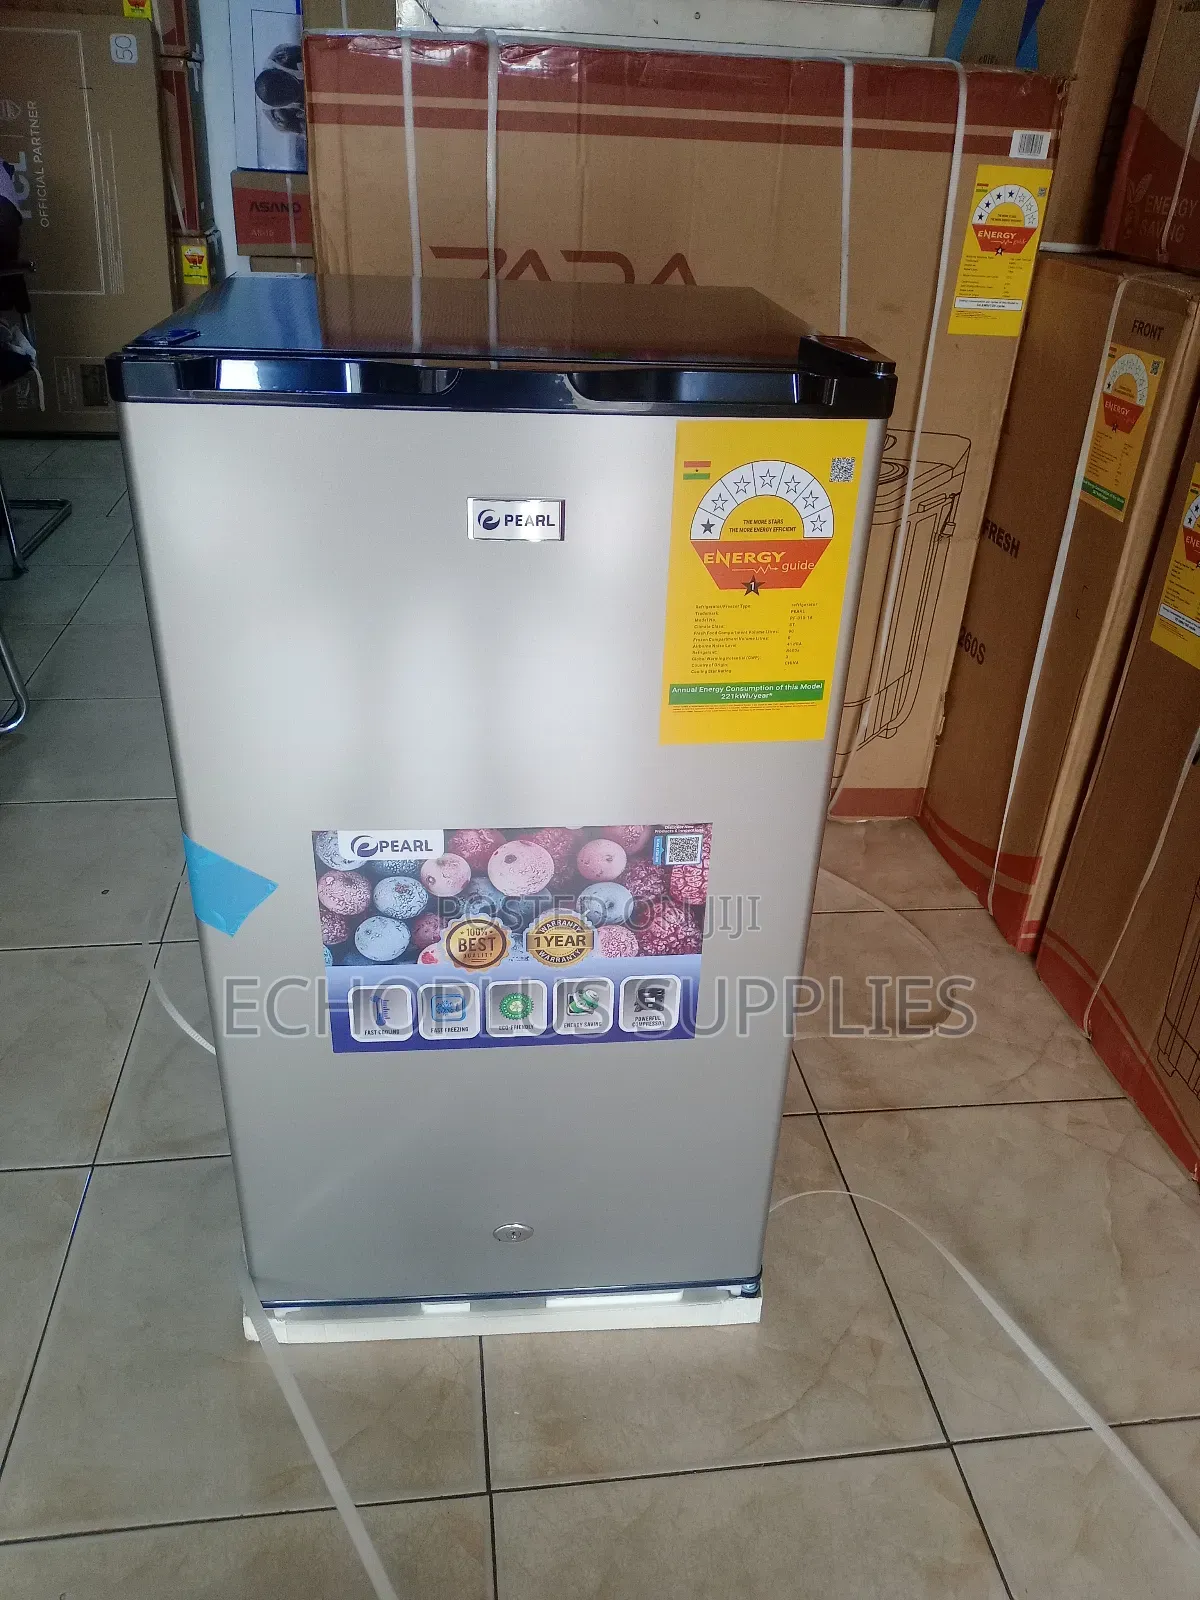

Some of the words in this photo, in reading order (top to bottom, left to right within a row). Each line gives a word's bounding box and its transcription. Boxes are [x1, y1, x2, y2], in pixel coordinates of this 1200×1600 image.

[115, 35, 133, 60] 50
[27, 100, 42, 166] PARTNER
[32, 167, 50, 228] OFFICIAL
[977, 229, 1018, 240] ENERGY
[1131, 319, 1165, 340] FRONT
[1104, 400, 1131, 416] ENERGY
[504, 514, 556, 527] PEARL
[981, 517, 1021, 559] FRESH
[703, 549, 786, 569] ENERGY
[781, 560, 815, 573] guide
[749, 581, 755, 591] 1
[726, 685, 774, 694] Consumption
[379, 840, 434, 852] PEARL
[466, 928, 488, 938] 100%
[540, 920, 581, 933] WARRANTY
[458, 937, 496, 953] BEST
[542, 935, 586, 948] YEAR
[538, 950, 581, 964] WARRANTY
